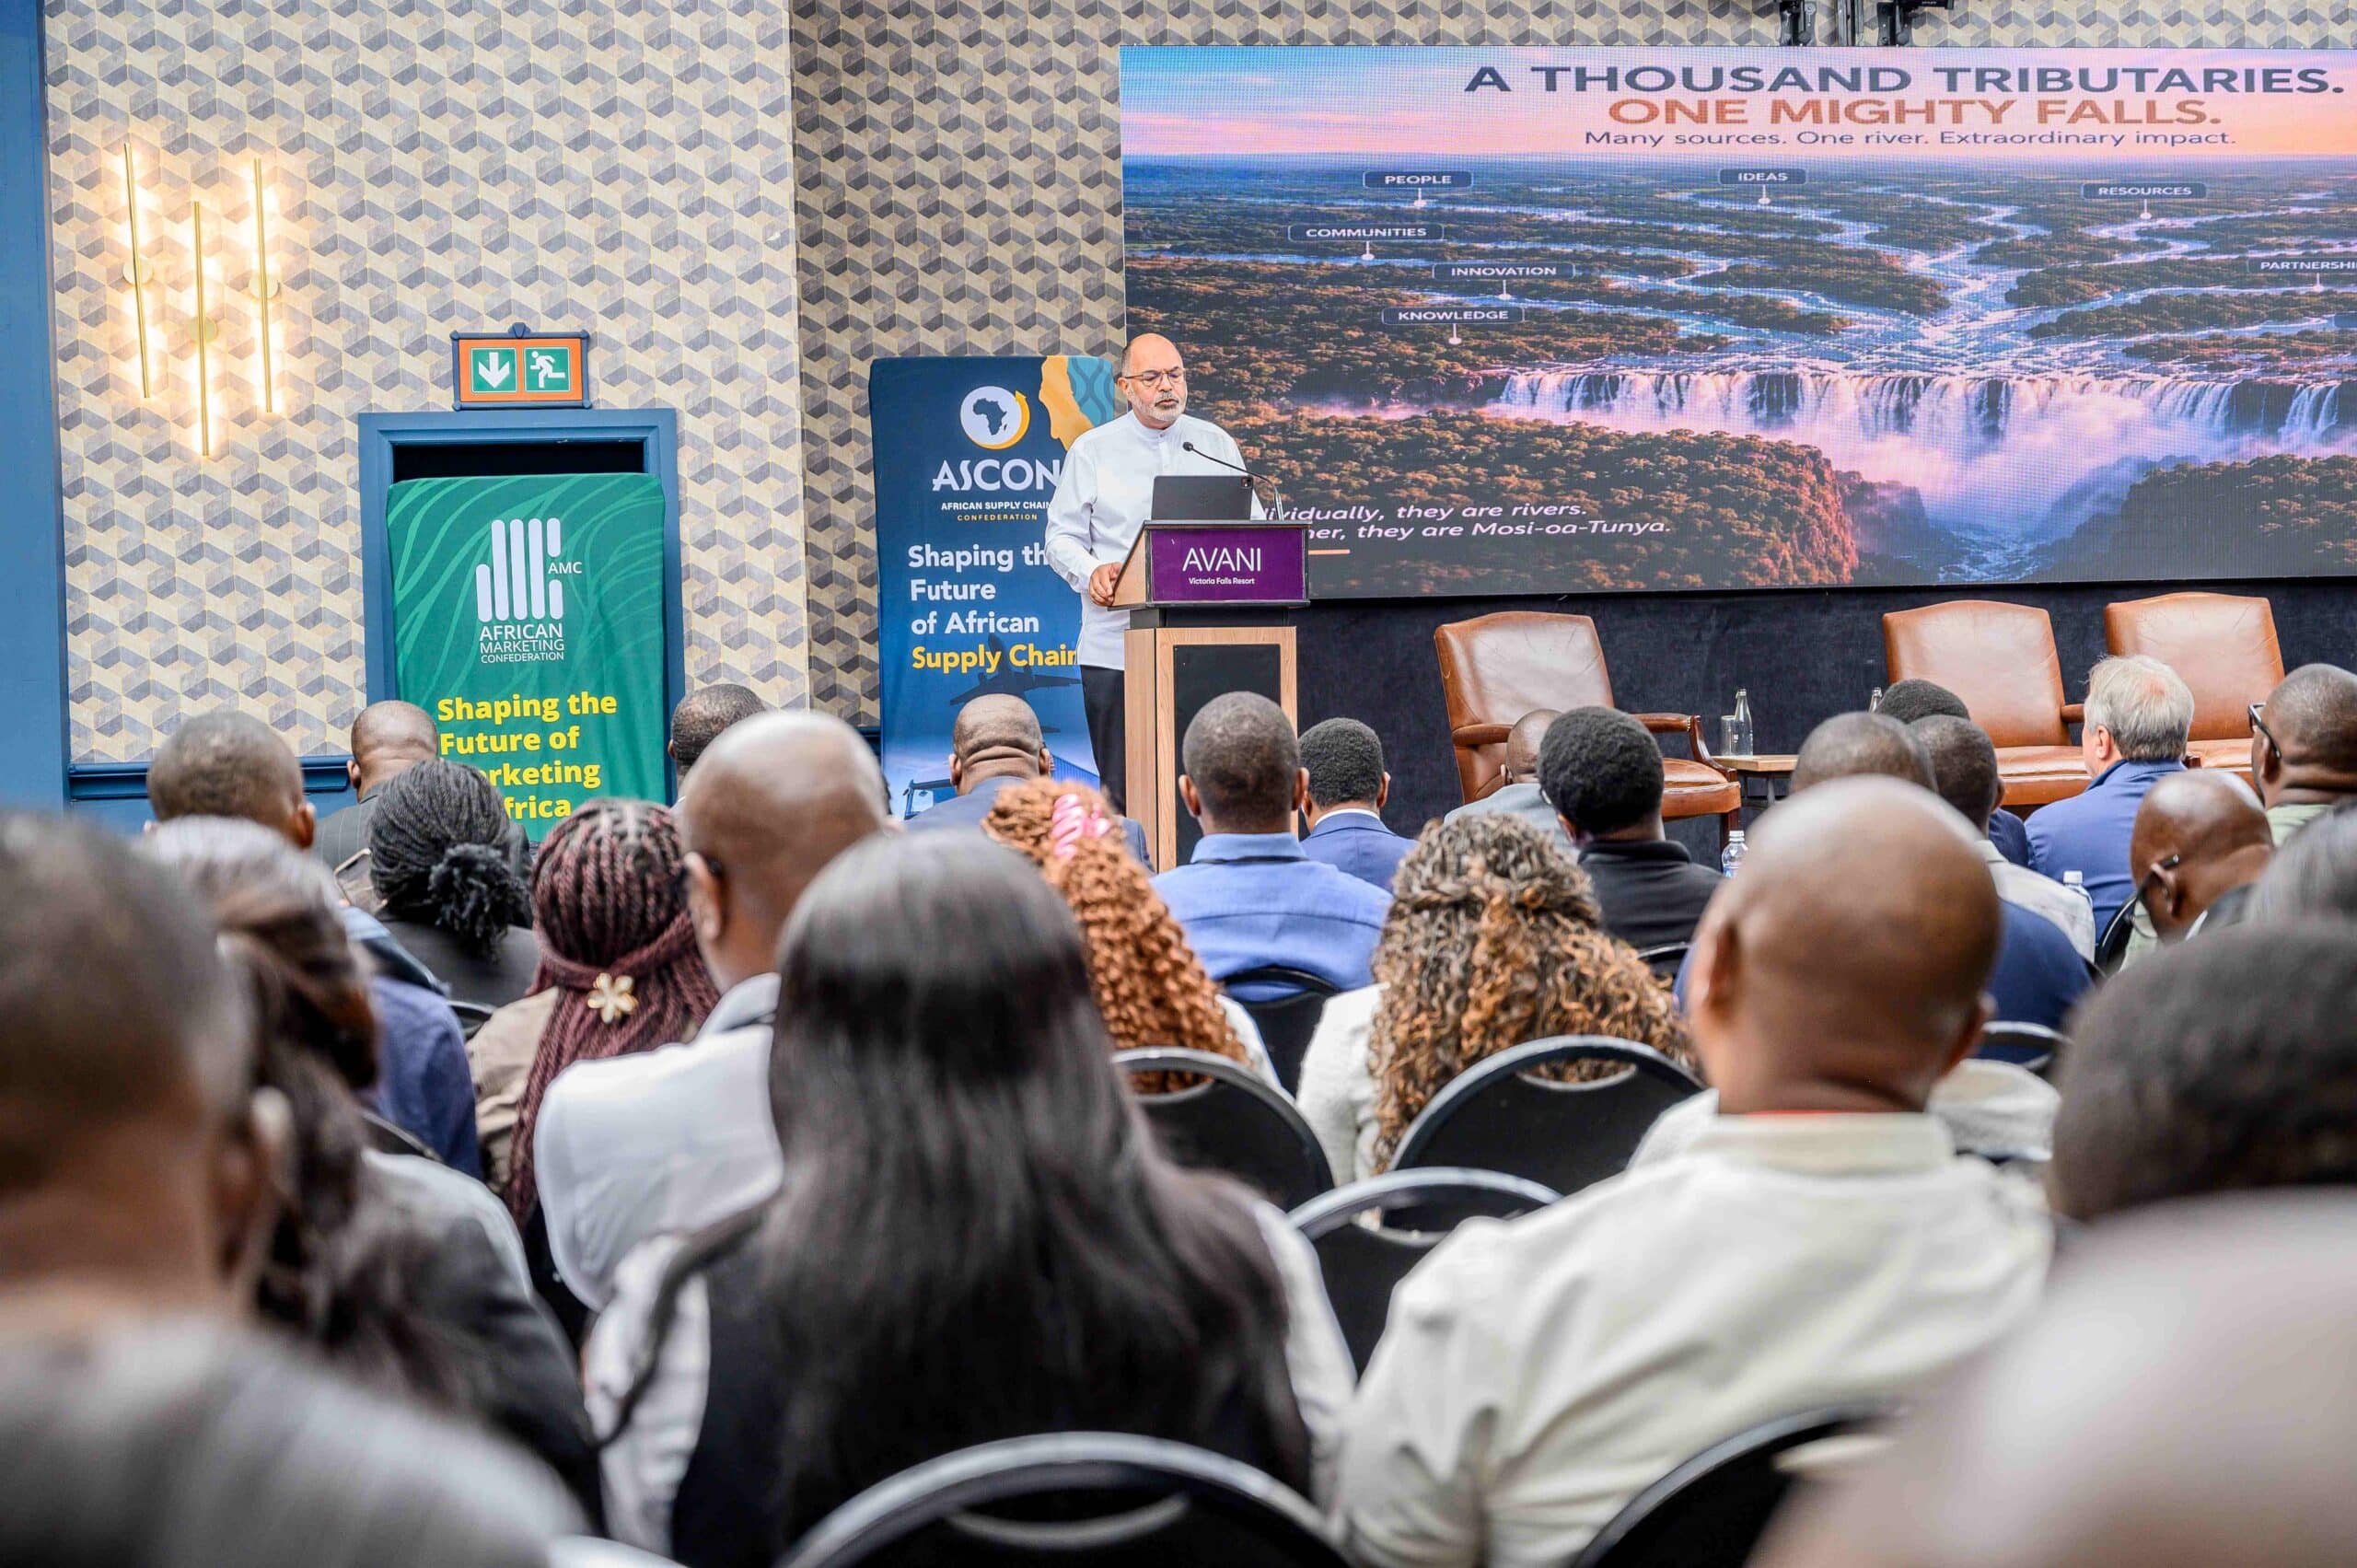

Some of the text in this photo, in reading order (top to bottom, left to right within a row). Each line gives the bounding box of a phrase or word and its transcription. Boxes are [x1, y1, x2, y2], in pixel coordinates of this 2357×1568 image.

[1464, 66, 2345, 94] A THOUSAND TRIBUTARIES.
[1608, 99, 2222, 125] ONE MIGHTY FALLS.
[1585, 131, 2236, 147] Many sources. One river. Extraordinary impact.
[1384, 175, 1452, 184] PEOPLE
[1737, 172, 1788, 181] IDEAS
[2098, 186, 2192, 196] RESOURCES
[1306, 226, 1427, 238] COMMUNITIES
[1450, 266, 1557, 276] INNOVATION
[2260, 261, 2357, 270] PARTNERSHI
[1398, 310, 1509, 320] KNOWLEDGE
[932, 459, 1061, 492] ASCON
[941, 502, 982, 511] AFRICAN
[984, 501, 1022, 510] SUPPLY
[1397, 505, 1455, 521] they
[1461, 506, 1504, 517] are
[1512, 504, 1587, 517] rivers.
[1357, 525, 1415, 540] they
[1422, 527, 1464, 537] are
[1471, 519, 1671, 536] Mosi-oa-Tunya.
[908, 542, 1048, 573] Shaping th
[1182, 547, 1261, 572] AVANI
[547, 562, 583, 575] AMC
[911, 579, 996, 601] Future
[479, 622, 563, 642] AFRICAN
[911, 611, 1039, 635] of African
[480, 639, 565, 654] MARKETING
[481, 651, 565, 664] CONFEDERATION
[911, 645, 1002, 673] Supply
[437, 691, 618, 725] Shaping the
[440, 726, 580, 755] Future of
[503, 796, 572, 819] frica
